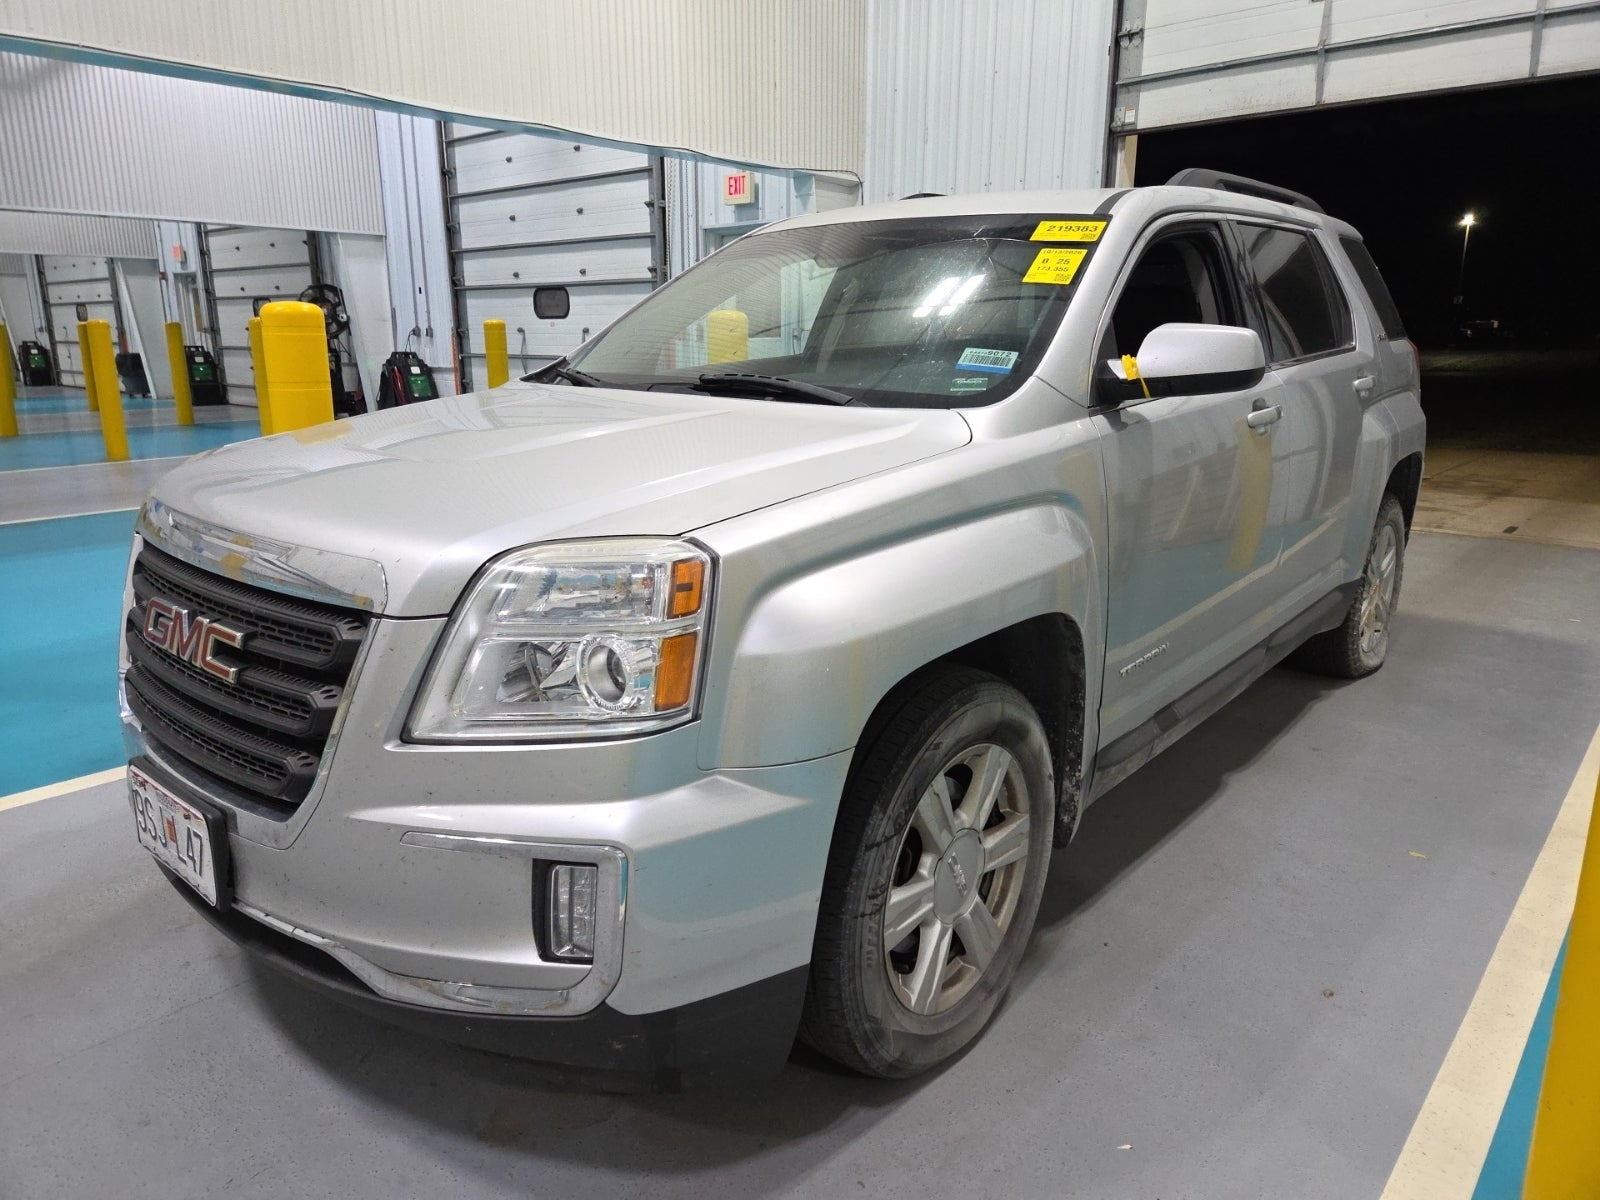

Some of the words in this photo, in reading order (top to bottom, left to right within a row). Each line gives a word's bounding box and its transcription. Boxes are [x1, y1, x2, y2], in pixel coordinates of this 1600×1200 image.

[728, 175, 746, 196] EXIT
[1046, 225, 1099, 233] 219383
[143, 597, 244, 685] GMC
[171, 815, 204, 878] L47
